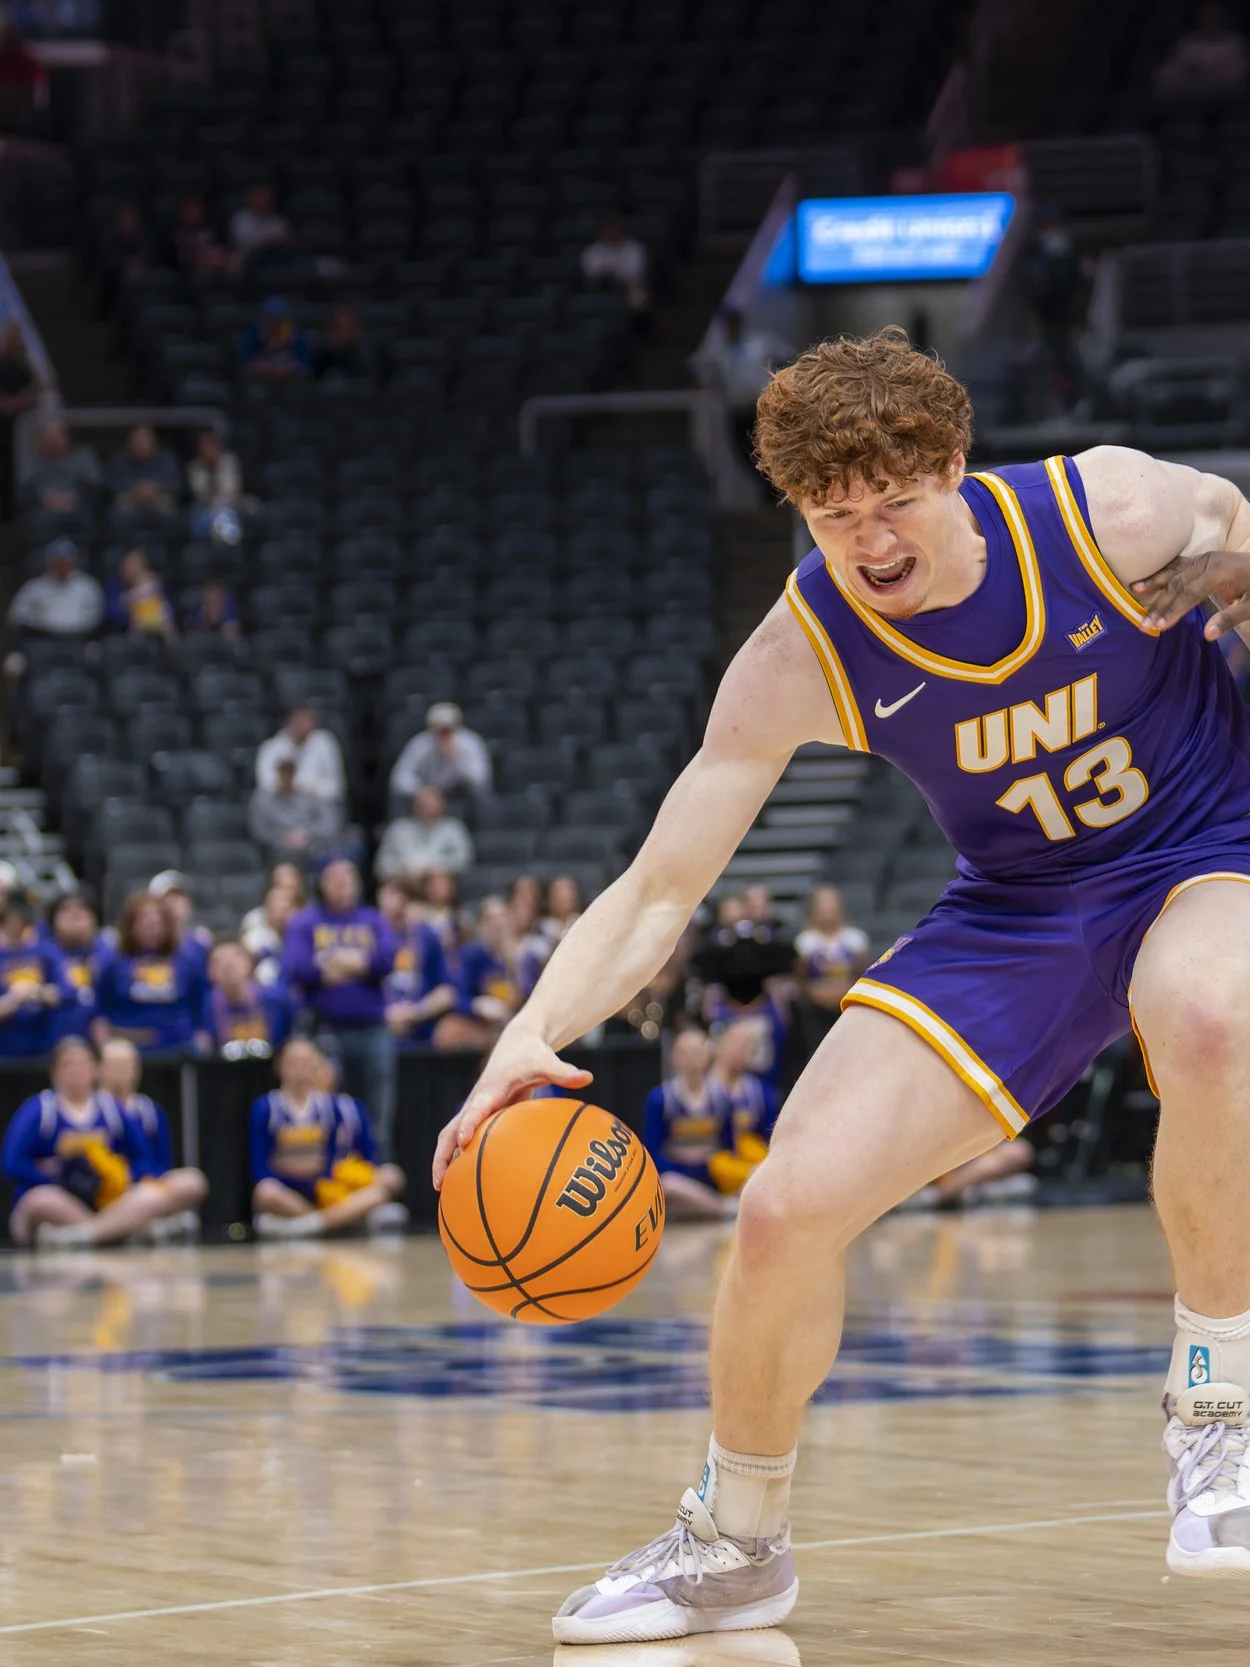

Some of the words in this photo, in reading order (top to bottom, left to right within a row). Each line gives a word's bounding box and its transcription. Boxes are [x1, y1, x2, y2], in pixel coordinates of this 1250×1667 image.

[1067, 613, 1104, 648] VALLEY
[955, 672, 1098, 773] UNI
[995, 736, 1150, 841] 13
[1217, 1401, 1244, 1409] CUT
